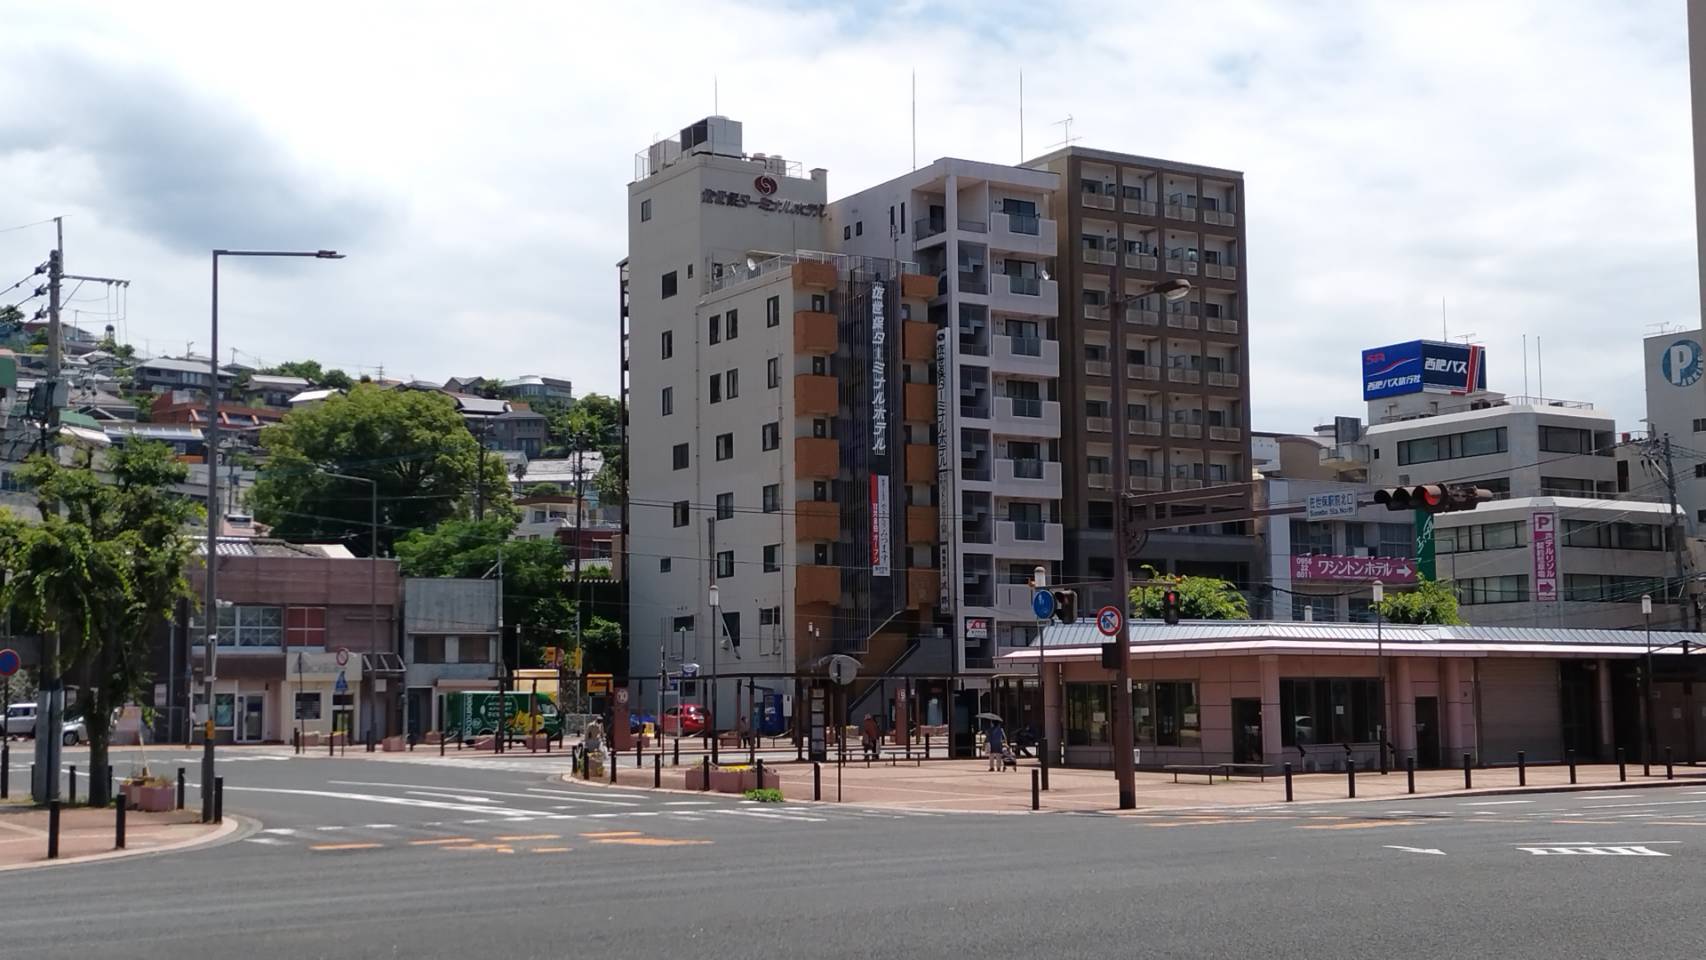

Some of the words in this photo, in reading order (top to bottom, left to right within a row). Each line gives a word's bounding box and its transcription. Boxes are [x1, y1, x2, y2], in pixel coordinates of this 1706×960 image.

[872, 287, 886, 450] 佐世保ターミナルホテル
[1424, 357, 1468, 375] 西肥バス
[1366, 374, 1421, 391] 西肥バス旅行社
[1310, 493, 1353, 508] 佐世保駅前北口
[1538, 516, 1550, 529] P
[1318, 560, 1393, 577] ワシントンホテル
